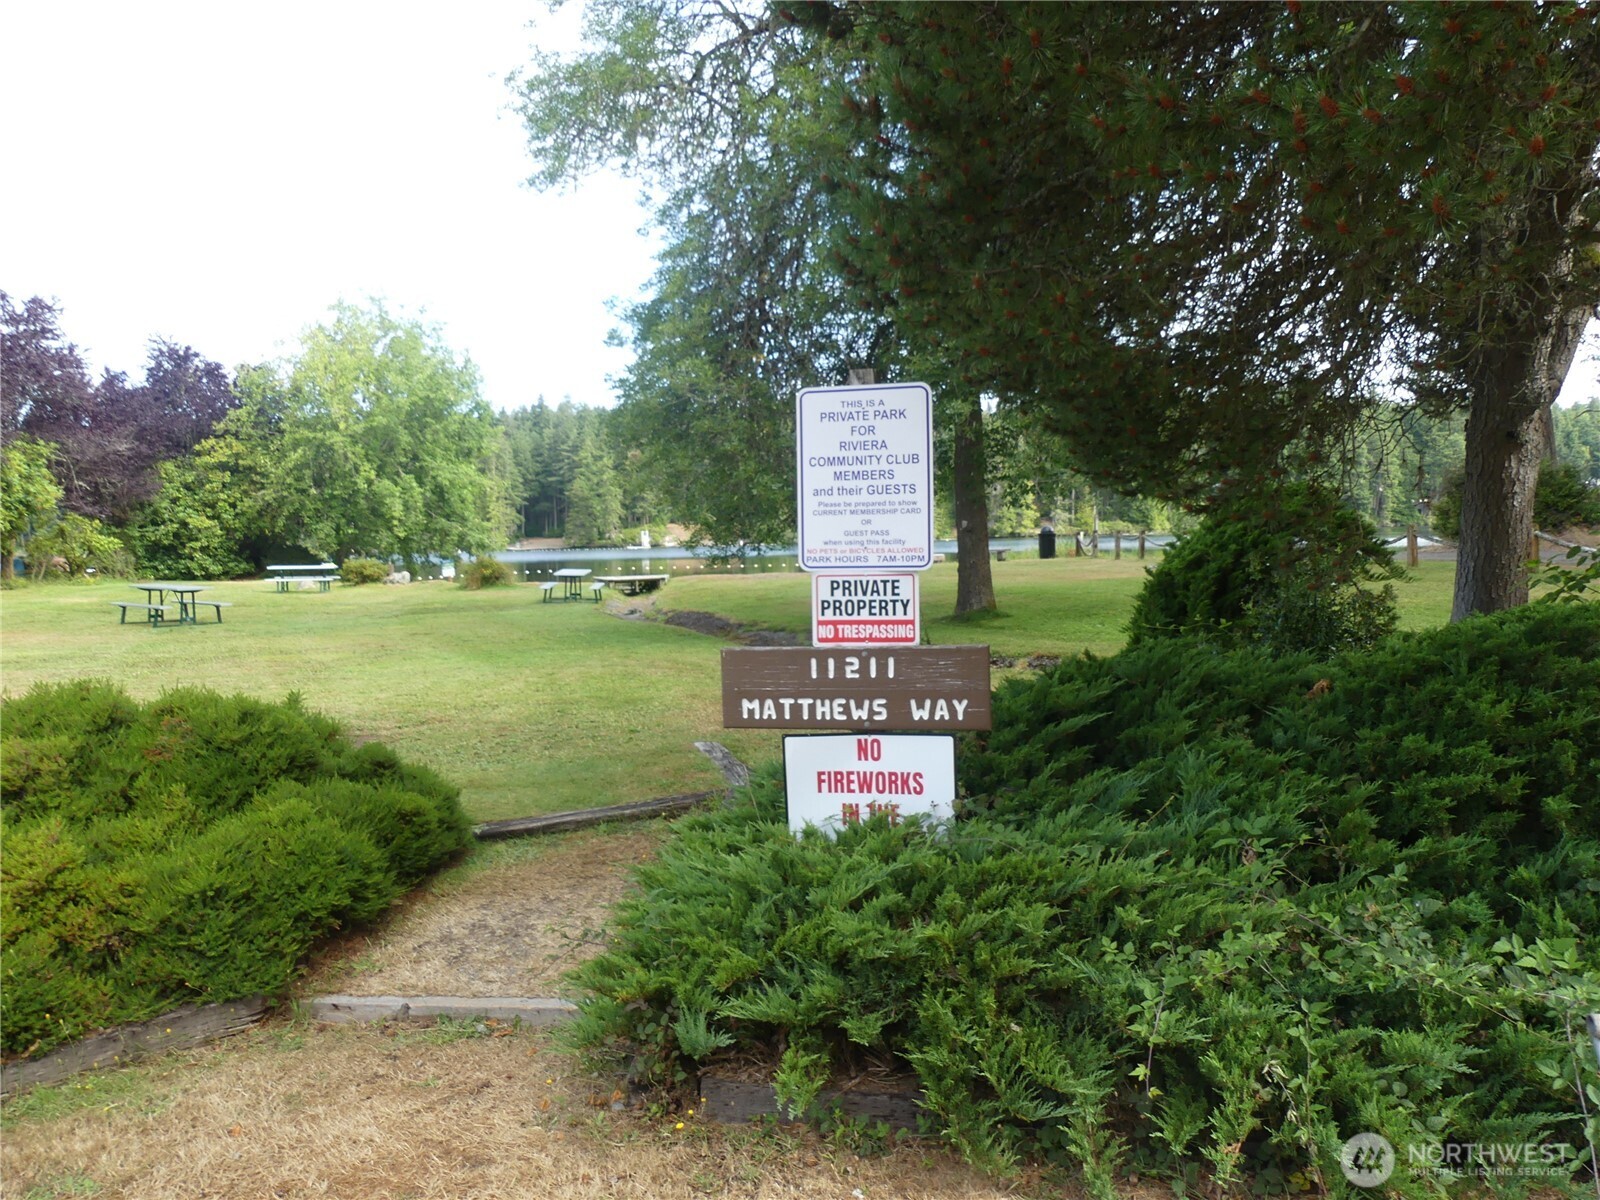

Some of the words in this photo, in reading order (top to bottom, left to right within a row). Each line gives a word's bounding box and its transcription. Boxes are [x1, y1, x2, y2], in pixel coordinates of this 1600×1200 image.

[840, 400, 862, 408] THIS
[820, 410, 869, 422] PRIVATE
[873, 409, 907, 420] PARK
[851, 425, 876, 436] FOR
[840, 440, 888, 451] RIVIERA
[809, 455, 882, 467] COMMUNITY
[886, 454, 920, 464] CLUB
[833, 470, 895, 481] MEMBERS
[813, 487, 833, 496] and
[837, 485, 863, 496] their
[866, 484, 917, 495] GUESTS
[854, 500, 886, 509] prepared
[830, 580, 900, 597] PRIVATE
[821, 599, 910, 616] PROPERTY
[819, 625, 835, 638] NO
[837, 624, 913, 638] TRESPASSING
[810, 656, 895, 679] 11211
[741, 698, 888, 721] MATTHEWS
[910, 698, 969, 721] WAY
[857, 738, 882, 762] NO
[817, 770, 924, 795] FIREWORKS
[842, 803, 859, 826] IN
